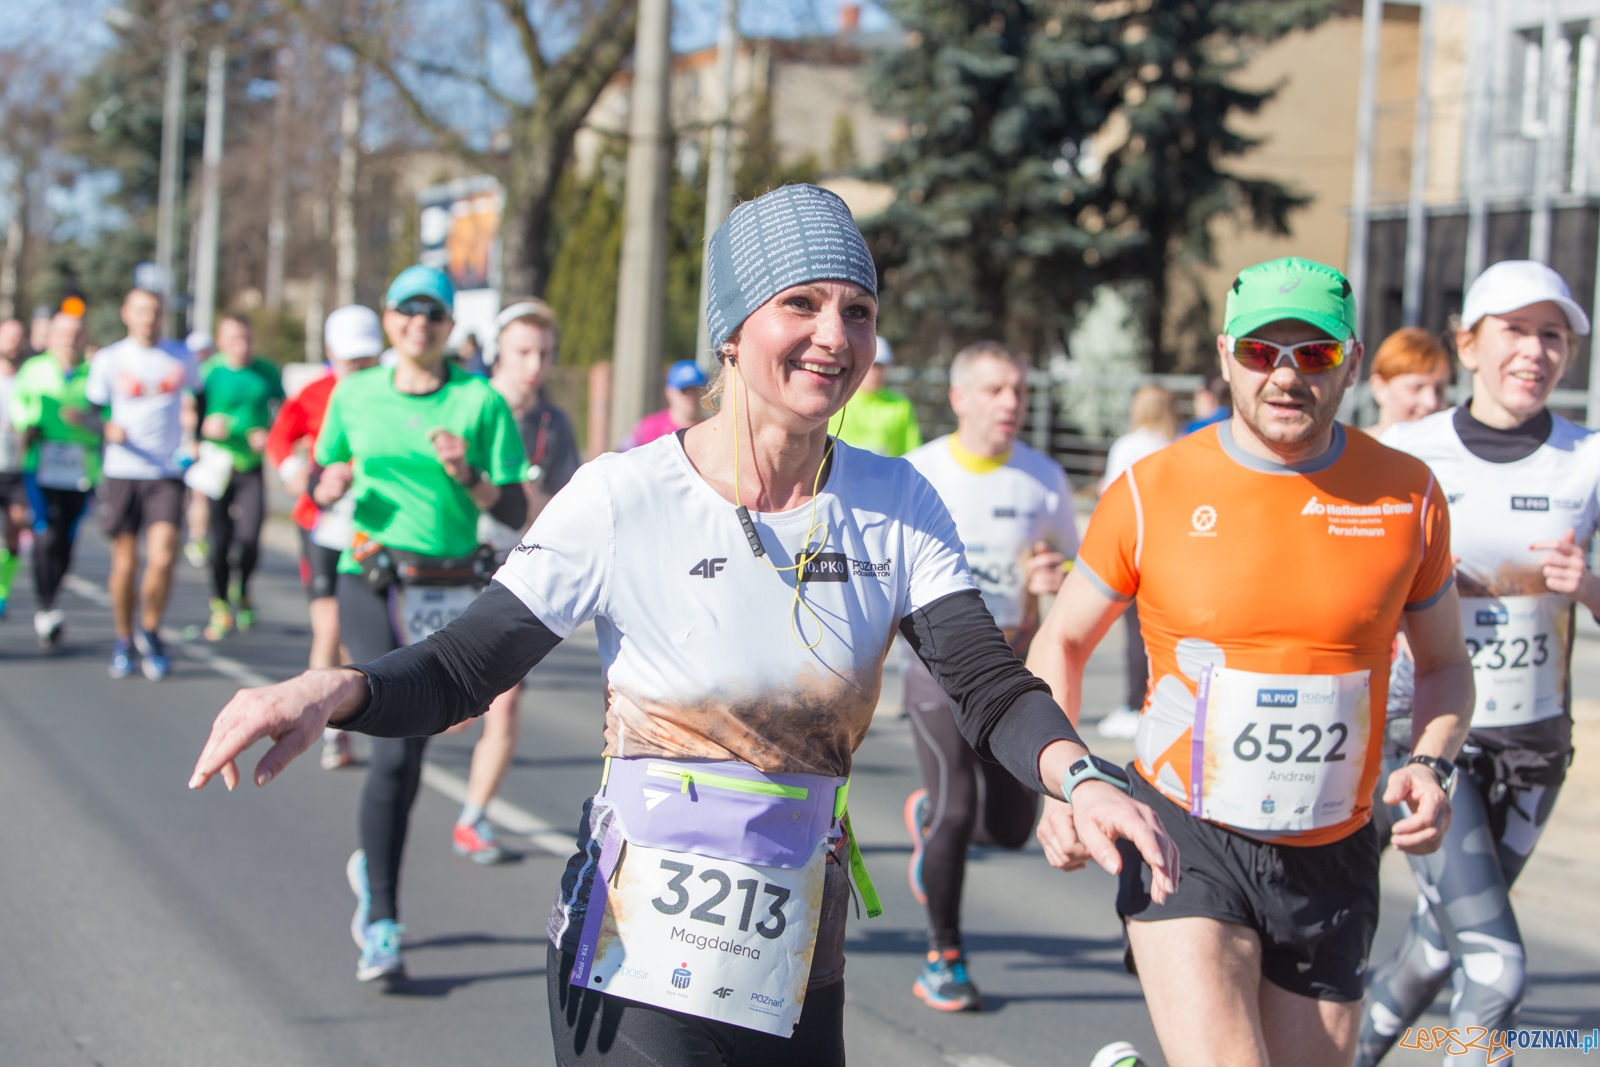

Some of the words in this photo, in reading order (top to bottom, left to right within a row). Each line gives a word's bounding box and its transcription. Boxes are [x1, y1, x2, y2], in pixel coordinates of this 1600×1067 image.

[1382, 503, 1413, 515] Group
[1328, 525, 1385, 537] Perschmann
[689, 558, 728, 578] 4F
[1233, 722, 1348, 763] 6522
[1268, 771, 1316, 784] Andrzej
[651, 859, 791, 940] 3213
[670, 926, 761, 960] Magdalena
[712, 987, 734, 999] 4F
